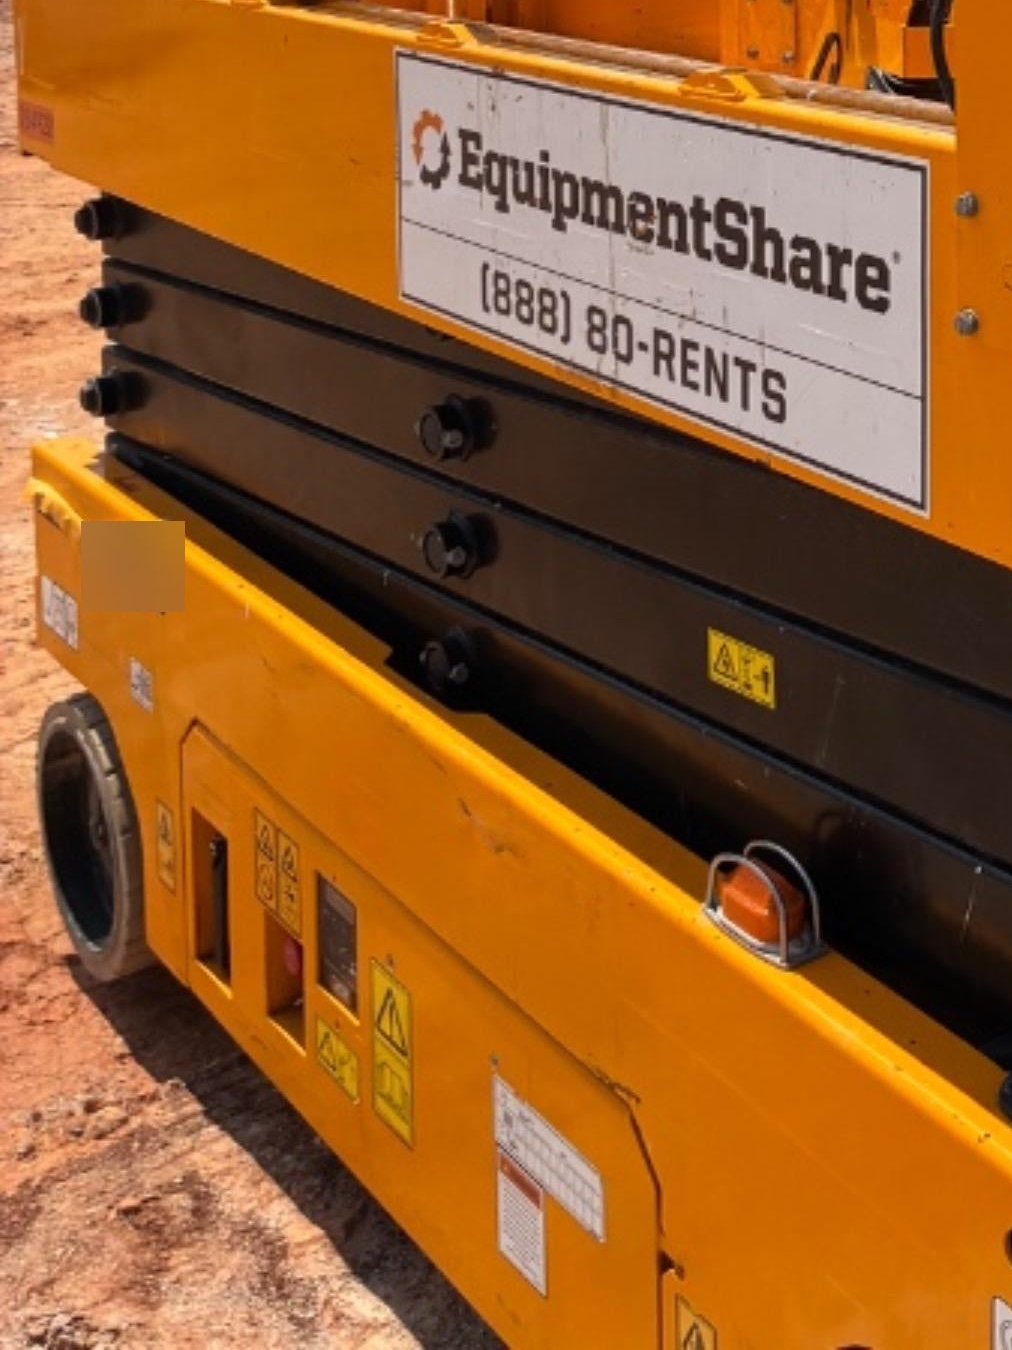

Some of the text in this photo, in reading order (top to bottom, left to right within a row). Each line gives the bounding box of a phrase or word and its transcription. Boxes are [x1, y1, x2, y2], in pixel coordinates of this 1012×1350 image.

[458, 127, 893, 315] EquipmentShare
[480, 261, 788, 424] (888) 80-RENTS
